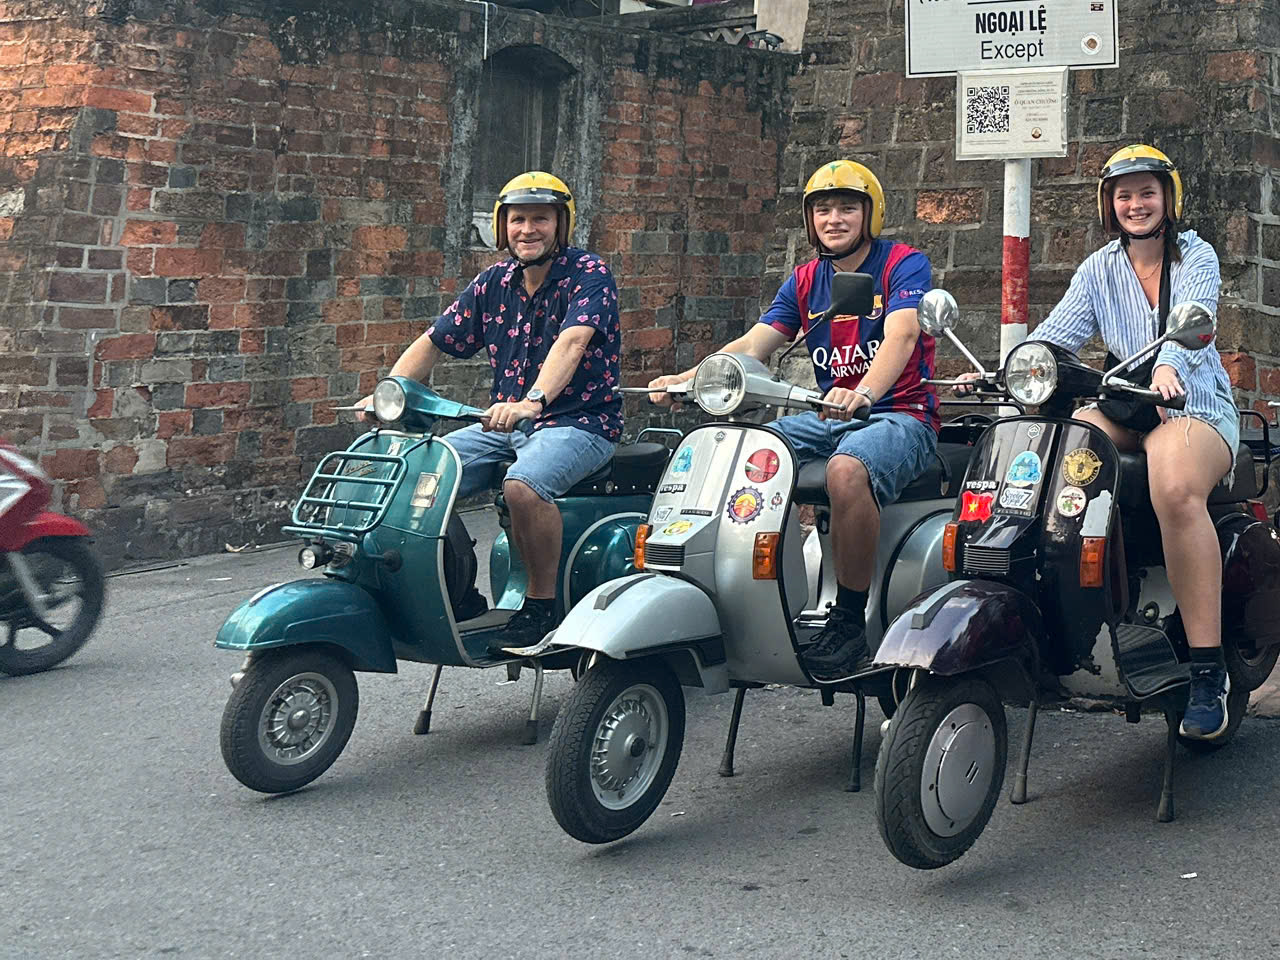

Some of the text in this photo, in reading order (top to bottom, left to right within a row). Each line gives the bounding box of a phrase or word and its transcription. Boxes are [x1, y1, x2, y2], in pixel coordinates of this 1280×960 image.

[975, 5, 1047, 36] NGOẠI LỆ
[981, 39, 1044, 62] Except
[812, 339, 880, 371] QATAR
[830, 359, 873, 378] AIRWA
[966, 481, 997, 491] vespa
